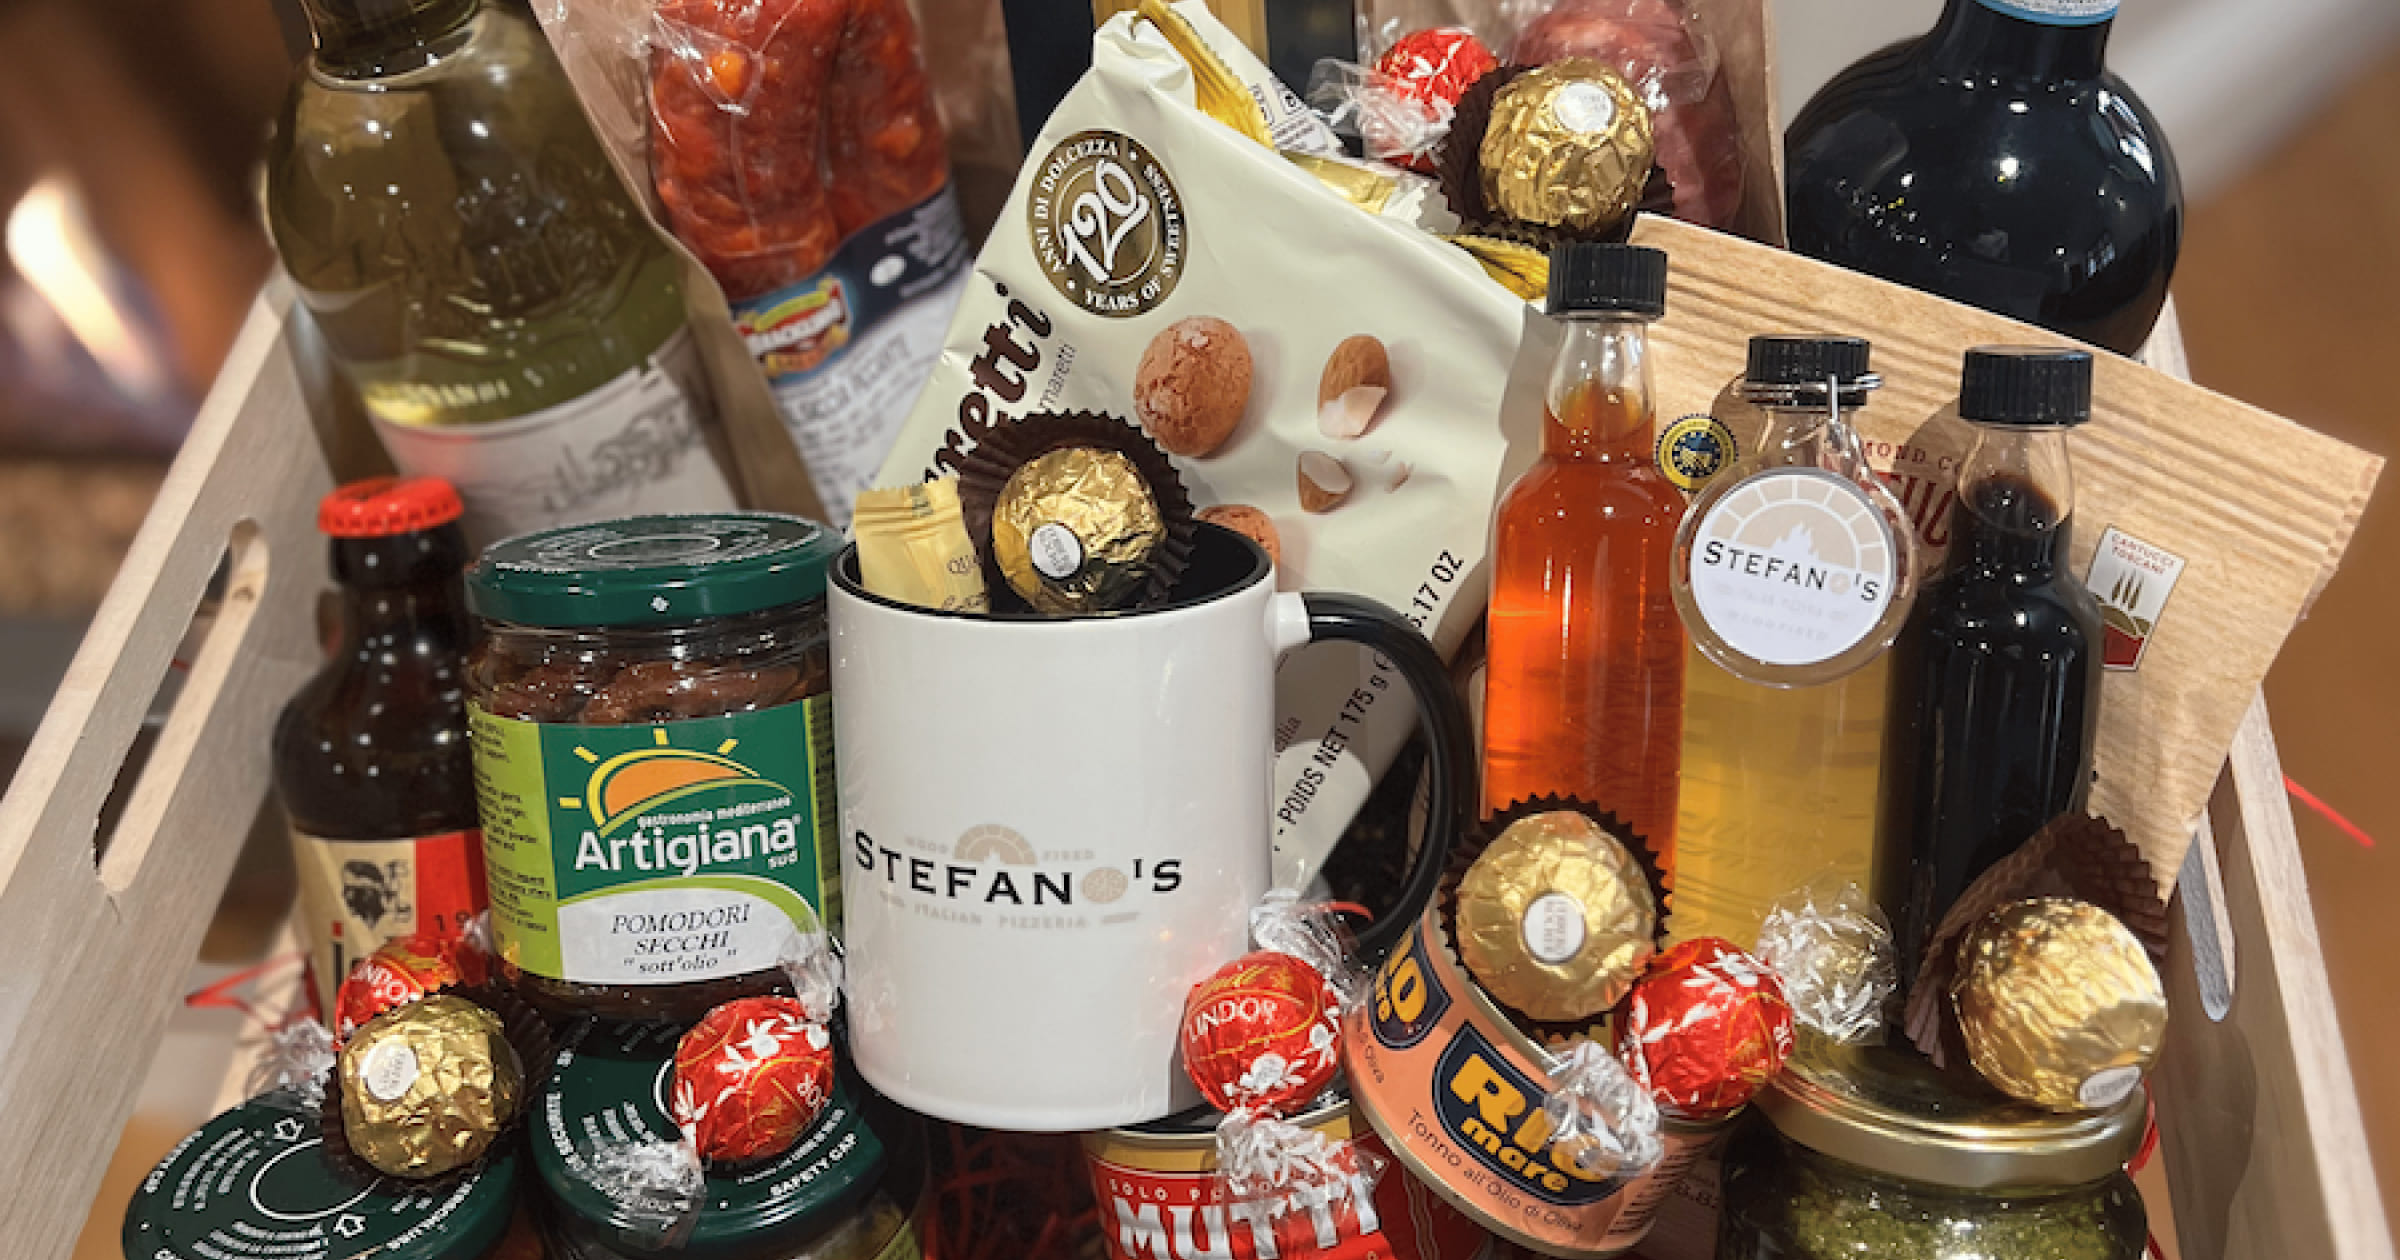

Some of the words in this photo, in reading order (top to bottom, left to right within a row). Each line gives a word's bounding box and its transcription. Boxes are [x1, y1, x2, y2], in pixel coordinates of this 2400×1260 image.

[1062, 159, 1151, 284] 120
[1084, 288, 1140, 311] YEARS
[1139, 273, 1162, 300] OF
[925, 282, 1052, 484] retti
[1277, 767, 1326, 826] POIDS
[1312, 725, 1349, 768] NET
[1341, 687, 1375, 724] 175
[1430, 549, 1465, 584] OZ
[767, 849, 798, 870] sud
[611, 902, 751, 935] POMODORI
[913, 903, 983, 926] ITALIAN
[998, 912, 1088, 930] PIZZERIA
[634, 930, 730, 957] SECCHI
[769, 1157, 829, 1198] SAFETY
[828, 1131, 859, 1163] CAP
[1409, 1106, 1462, 1168] Tonno
[1523, 1202, 1541, 1219] di
[1460, 1116, 1570, 1195] mare
[1108, 1177, 1169, 1201] SOLO
